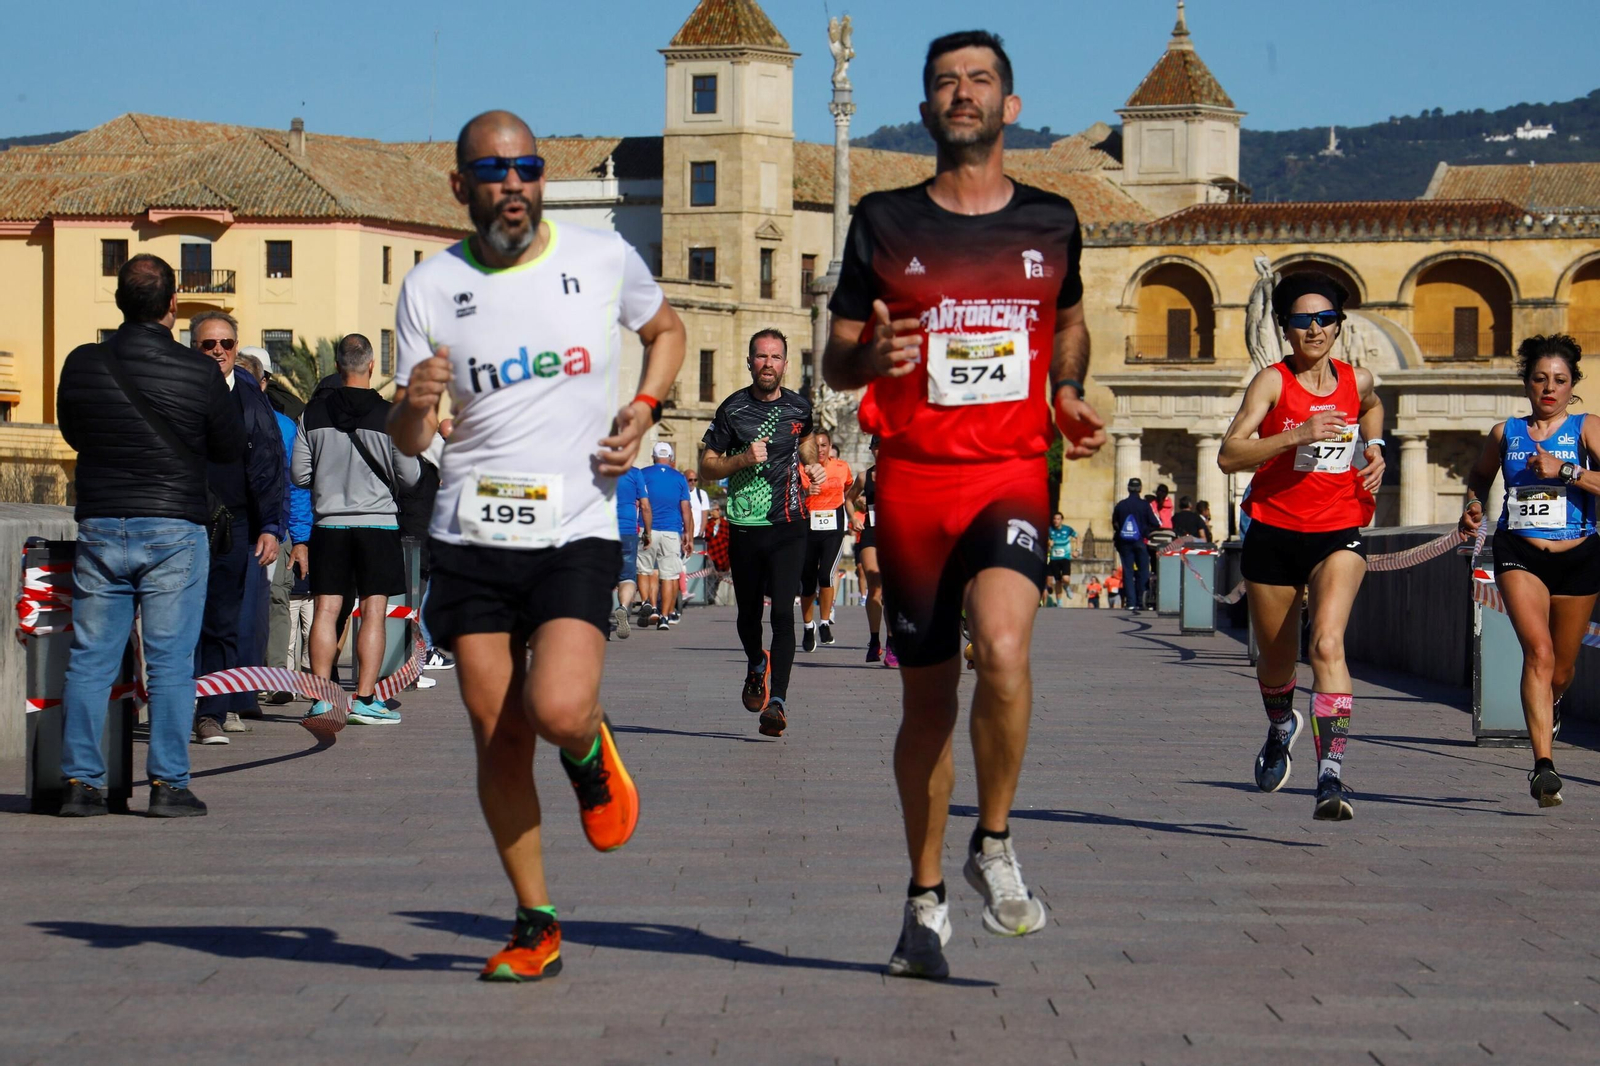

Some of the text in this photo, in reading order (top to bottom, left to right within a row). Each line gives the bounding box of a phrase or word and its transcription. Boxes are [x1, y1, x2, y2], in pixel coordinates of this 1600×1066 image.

[561, 273, 580, 294] in
[925, 304, 1028, 333] ANTORCHA
[468, 346, 591, 393] indea
[951, 364, 1006, 384] 574
[1312, 446, 1346, 459] 177
[481, 503, 536, 525] 195
[1519, 504, 1550, 516] 312
